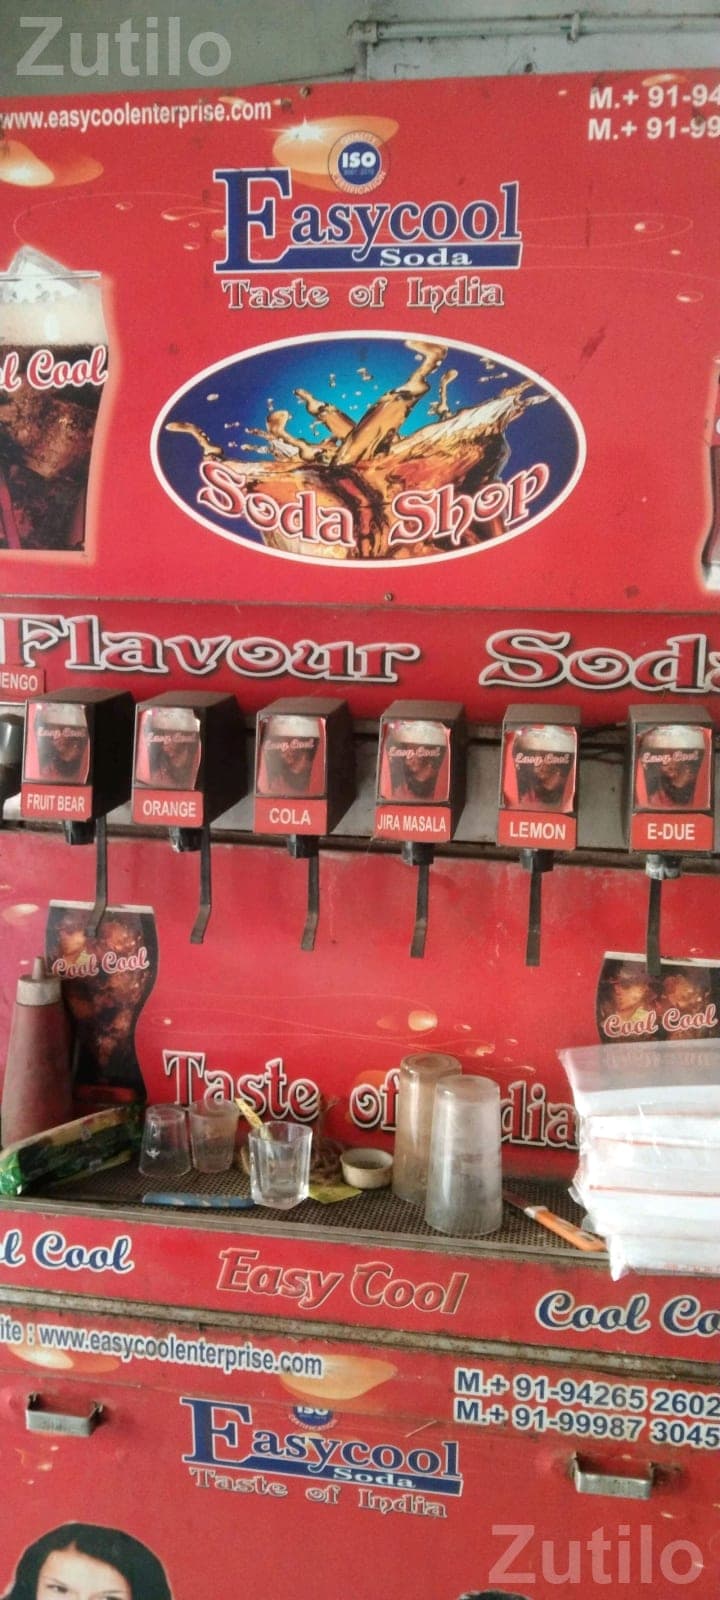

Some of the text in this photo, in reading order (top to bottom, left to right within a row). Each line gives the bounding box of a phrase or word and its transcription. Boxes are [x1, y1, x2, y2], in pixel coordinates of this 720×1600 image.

[0, 101, 271, 133] www.easycoolenterprise.com
[646, 114, 720, 140] 91-99
[342, 151, 377, 169] ISO
[213, 167, 523, 273] Easycool
[379, 248, 472, 267] Soda
[221, 275, 505, 313] Taste of India
[27, 344, 109, 390] Cool
[197, 460, 551, 548] Soda Shop
[0, 612, 720, 694] Flavour Sod
[0, 671, 38, 691] ENGO
[27, 793, 85, 812] FRUIT BEAR
[142, 800, 196, 818] ORANGE
[269, 807, 311, 825] COLA
[377, 814, 446, 832] JIRA MASALA
[509, 821, 566, 840] LEMON
[647, 823, 695, 841] E-DUE
[52, 946, 150, 978] Cool Cool
[603, 1003, 719, 1038] Cool Cool
[162, 1049, 323, 1122] Taste
[348, 1068, 400, 1131] of
[32, 1230, 135, 1275] Cool
[216, 1246, 469, 1314] Easy Cool
[535, 1289, 651, 1334] Cool
[37, 1323, 323, 1377] www.easycoolenterprise.com
[514, 1375, 646, 1411] 91-94265
[651, 1389, 720, 1417] 2602
[180, 1396, 462, 1480] Easycool
[513, 1405, 644, 1440] 91-99987
[650, 1419, 720, 1449] 3045
[189, 1466, 447, 1519] Taste of India
[333, 1467, 416, 1489] Soda
